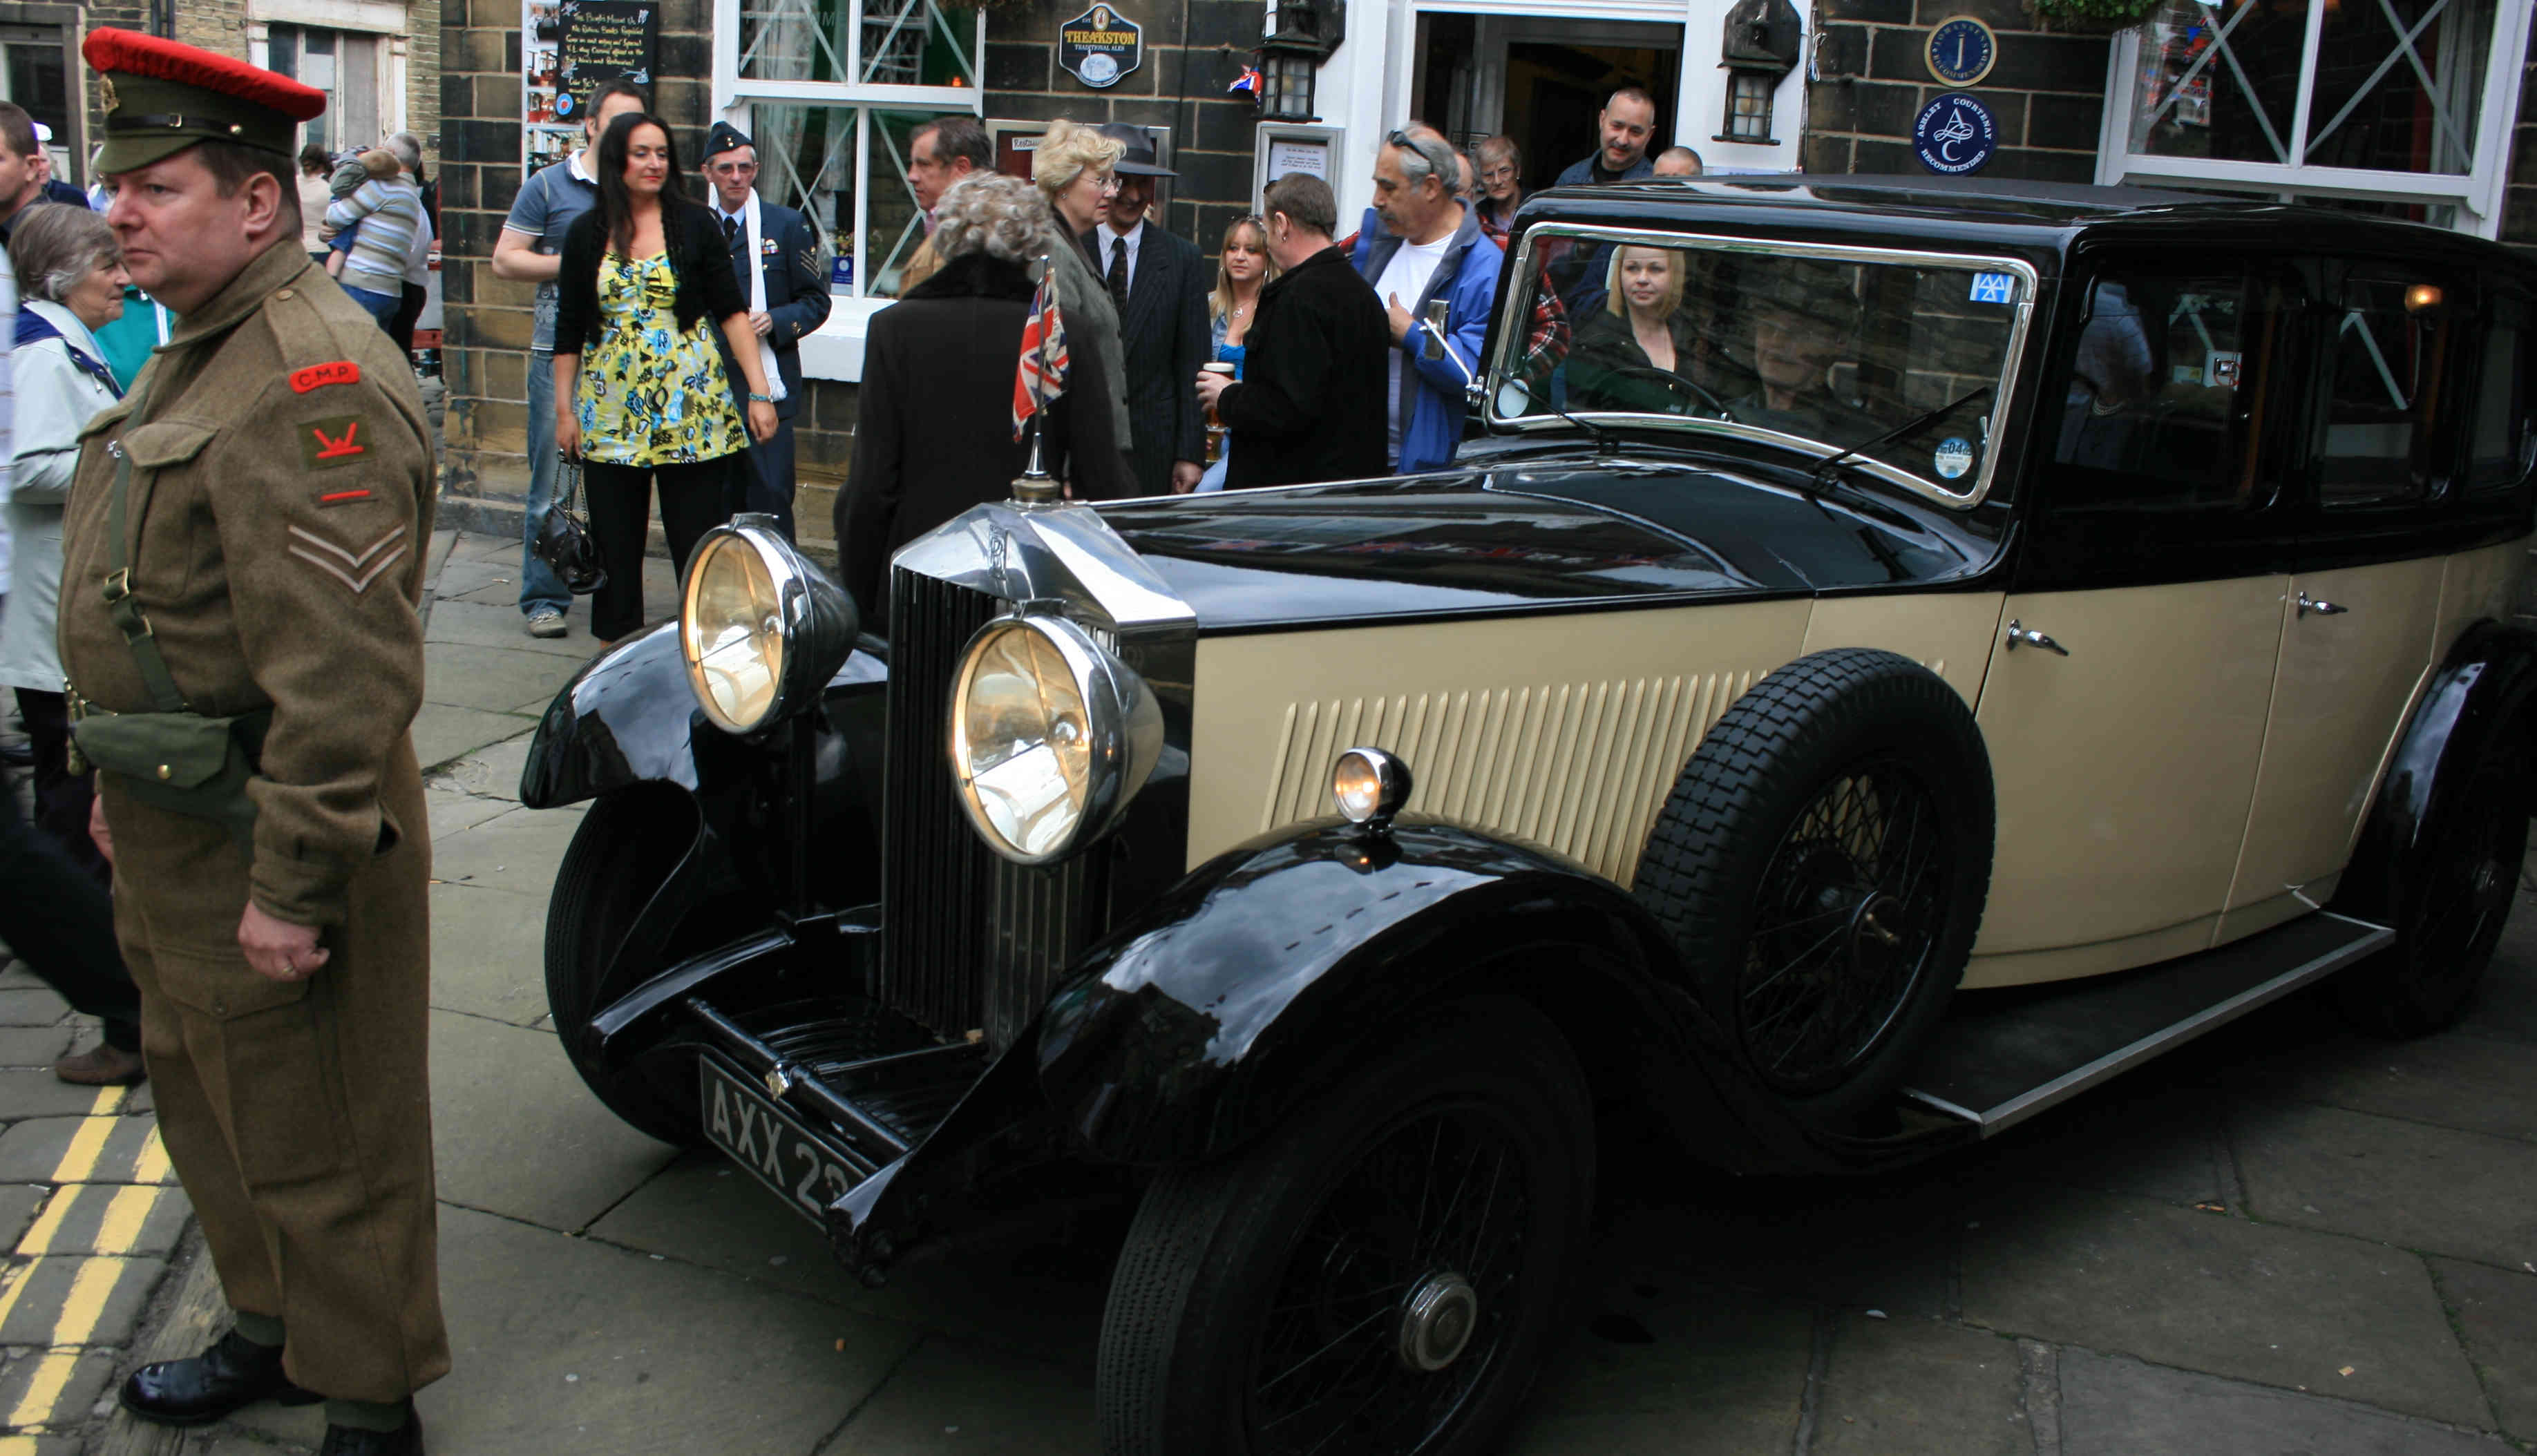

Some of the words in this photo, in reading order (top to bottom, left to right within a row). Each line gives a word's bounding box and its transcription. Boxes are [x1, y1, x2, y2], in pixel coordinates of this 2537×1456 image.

[1065, 30, 1137, 45] THEAKSTON
[1917, 102, 1941, 137] ASHLEY
[1953, 97, 1991, 140] COURTENAY
[1921, 148, 1986, 172] RECOMMENDED
[712, 1079, 786, 1188] AXX
